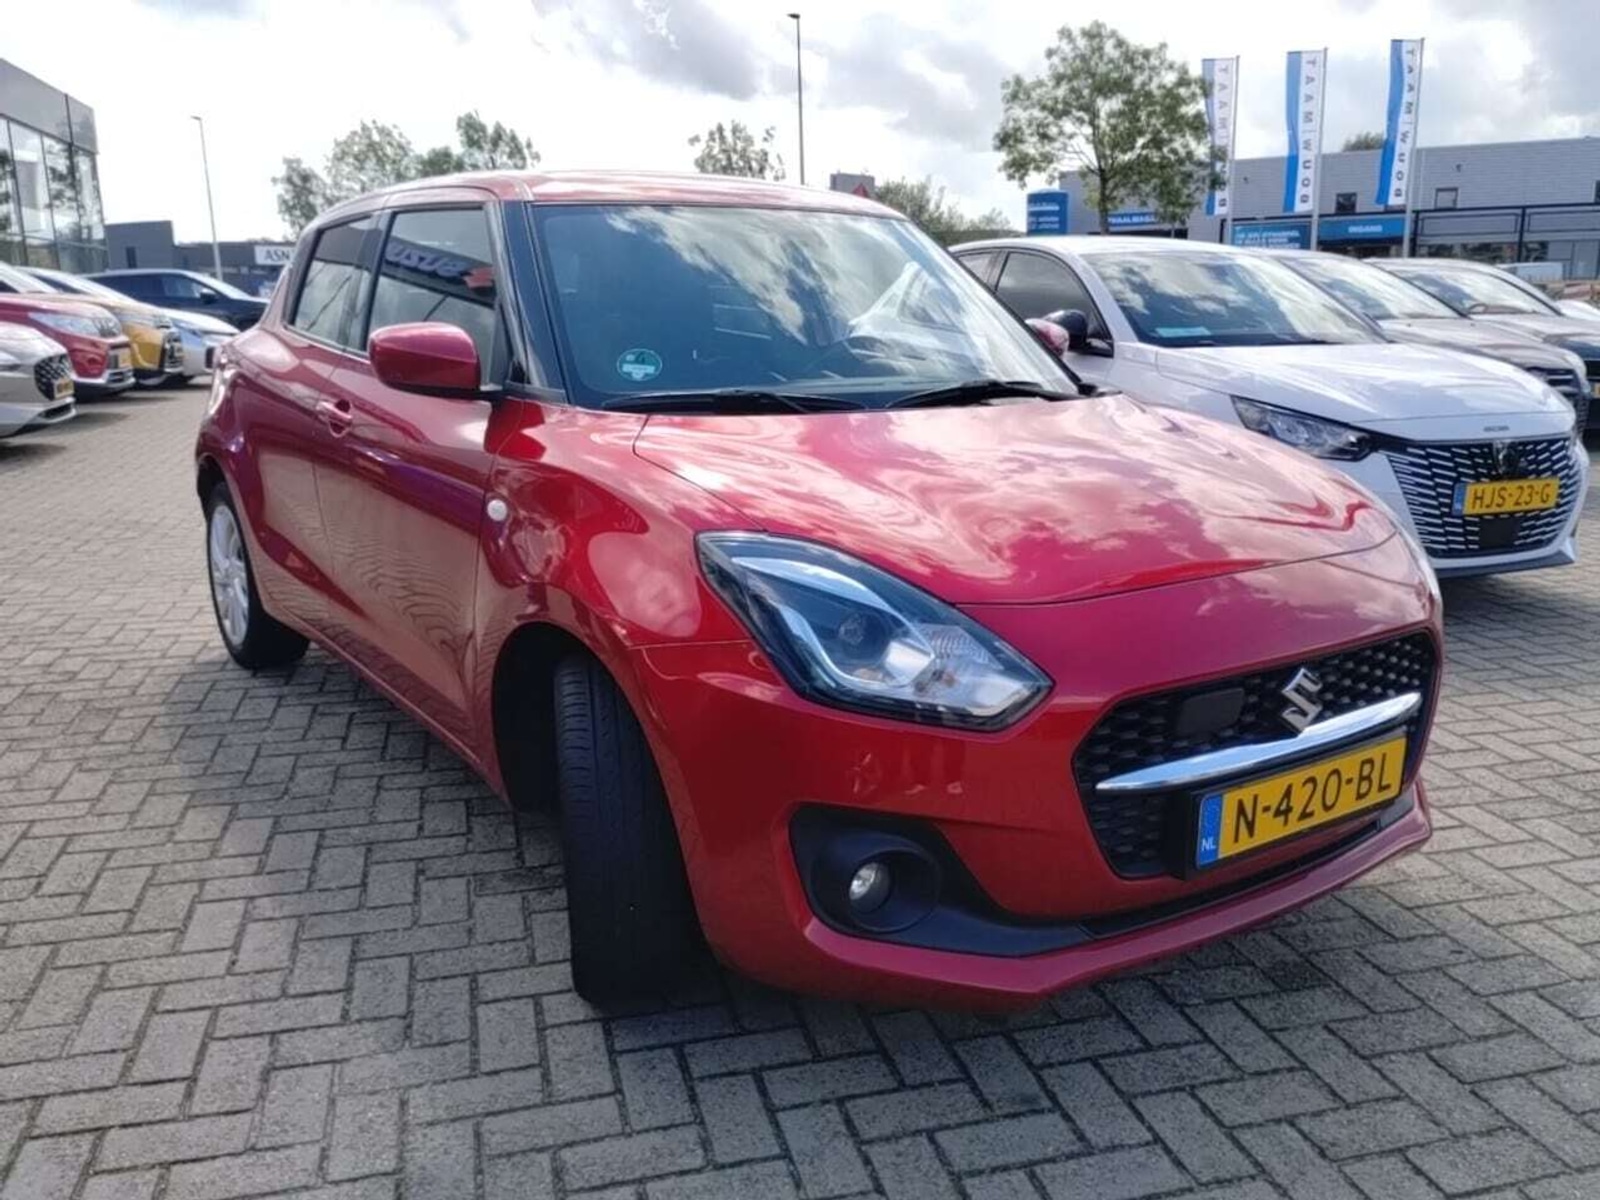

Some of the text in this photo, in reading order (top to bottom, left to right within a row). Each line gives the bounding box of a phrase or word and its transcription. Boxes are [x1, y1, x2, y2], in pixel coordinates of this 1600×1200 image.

[1471, 482, 1552, 509] HJS-23-G
[1233, 752, 1392, 843] N-420-BL
[1201, 836, 1217, 851] NL
